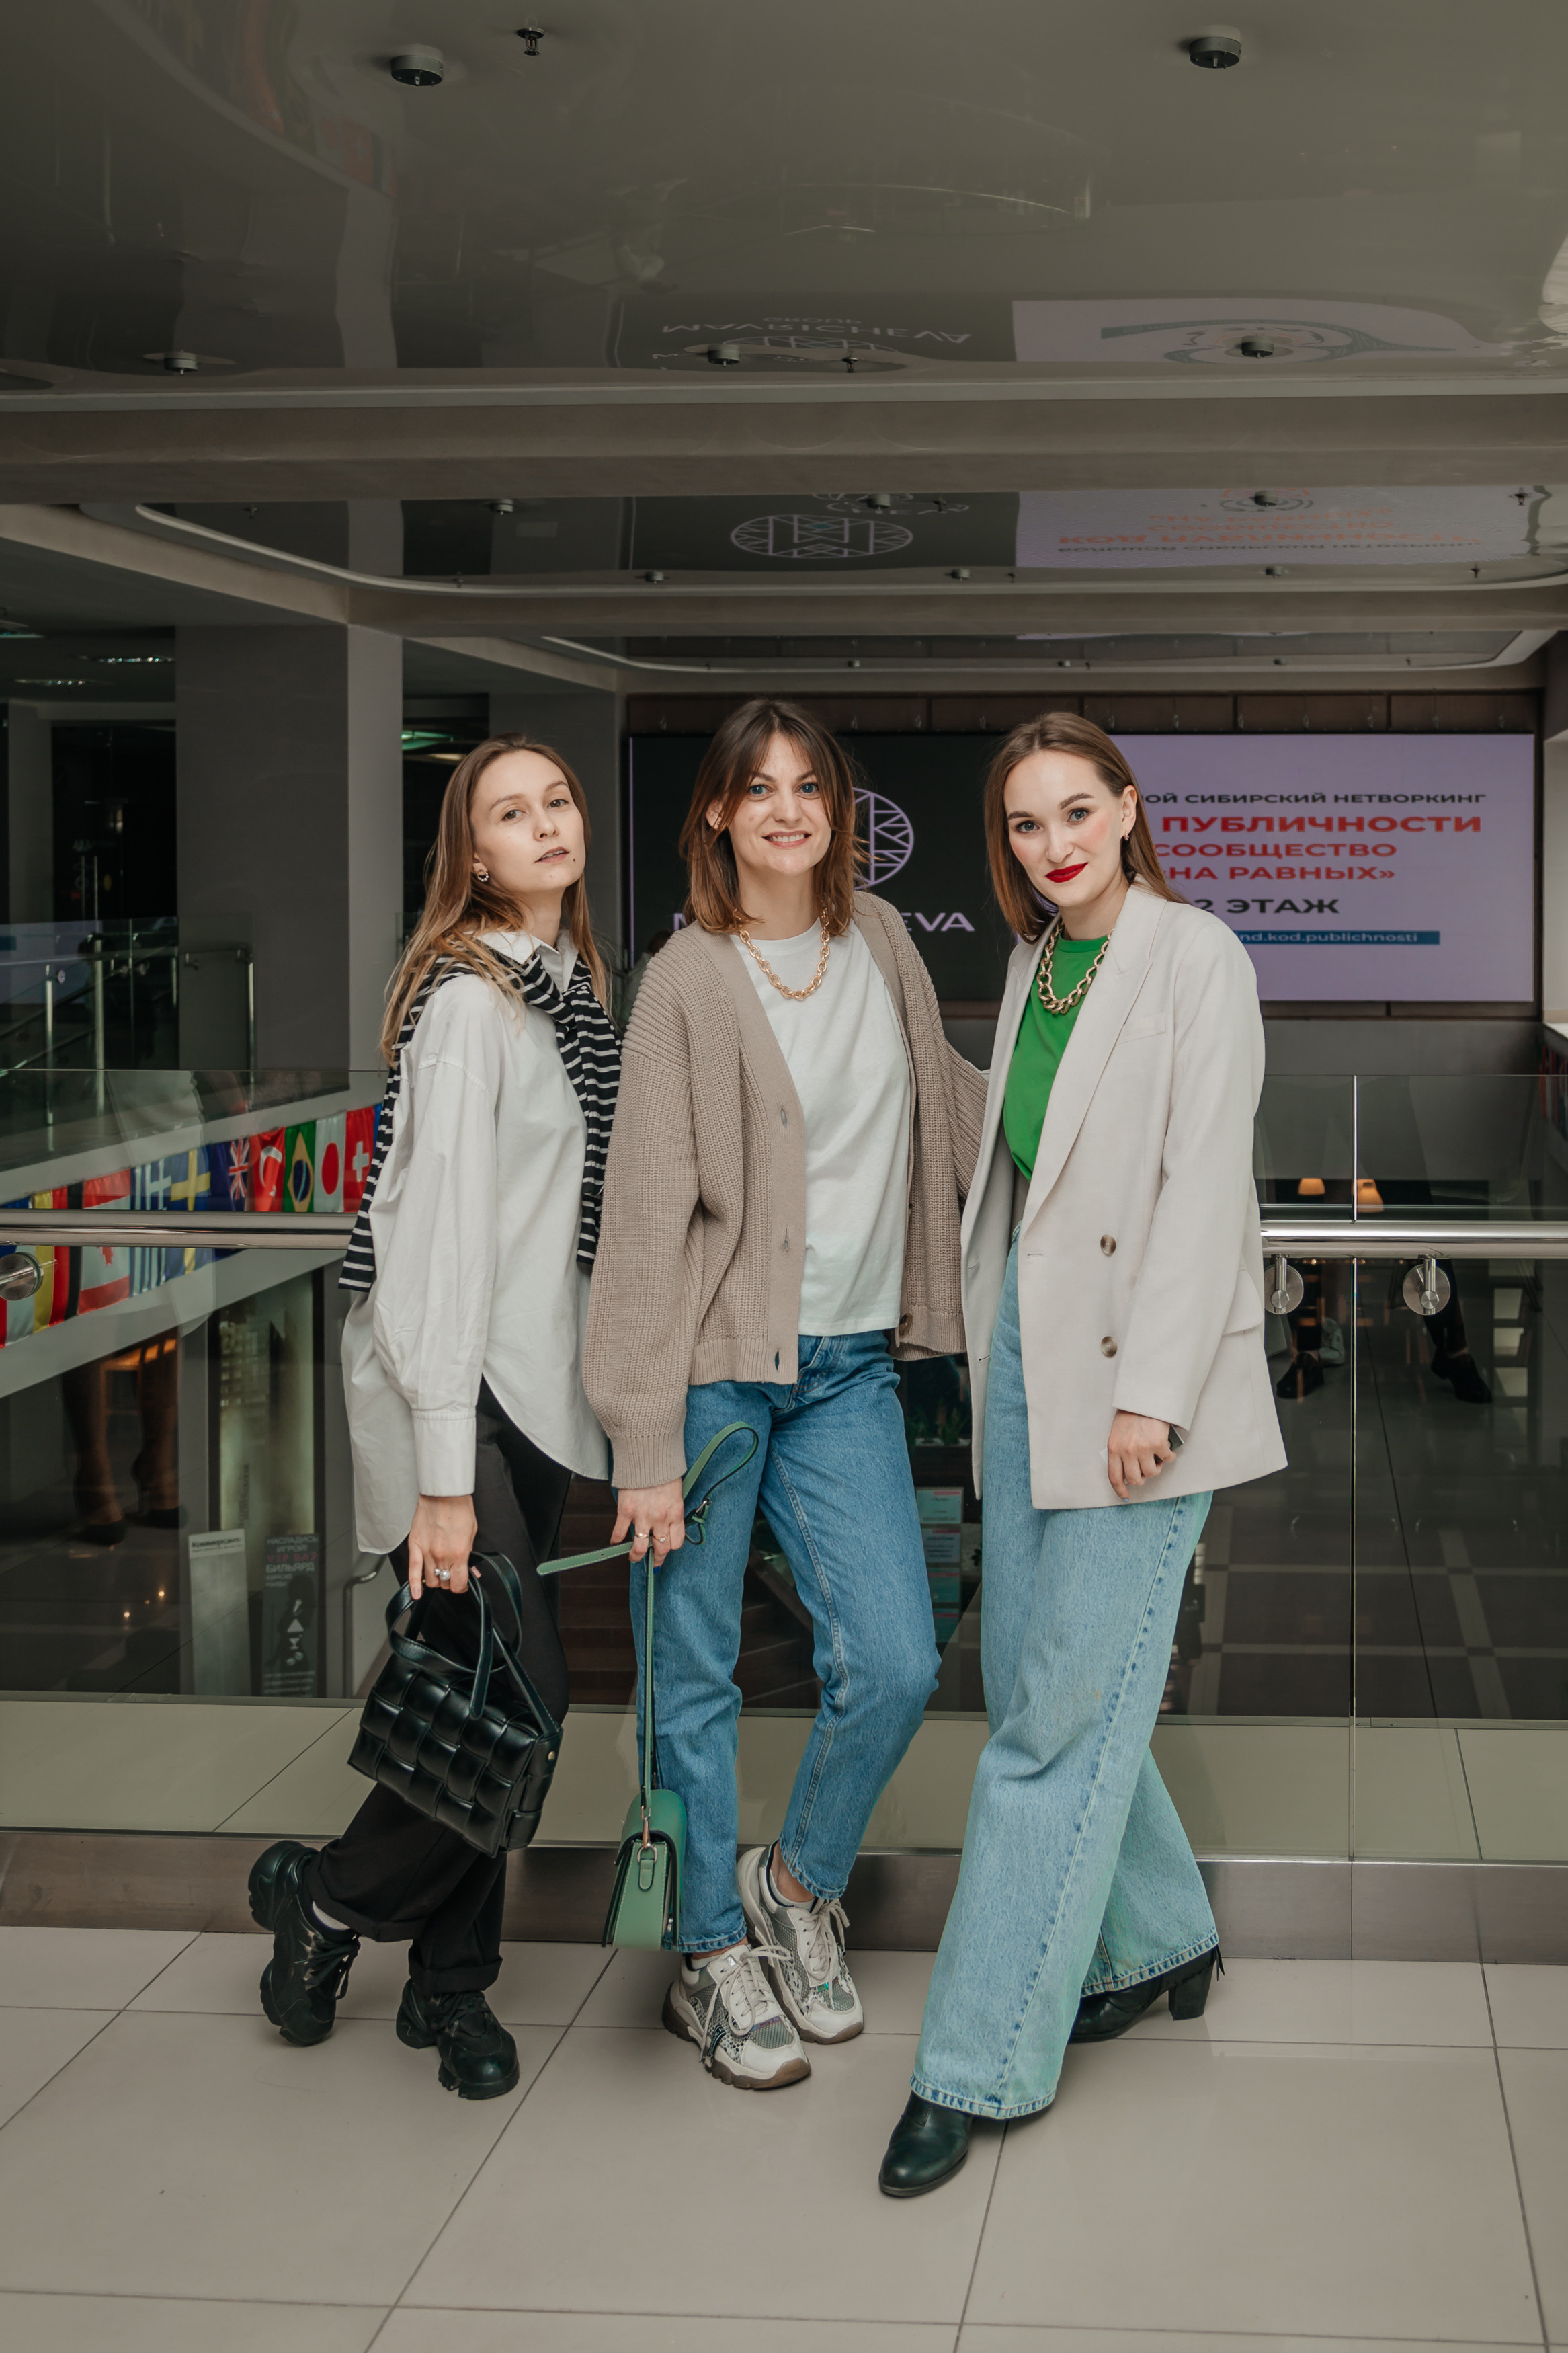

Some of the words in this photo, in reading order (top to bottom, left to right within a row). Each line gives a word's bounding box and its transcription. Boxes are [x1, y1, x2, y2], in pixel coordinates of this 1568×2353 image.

[1141, 793, 1178, 803] ОЙ
[1185, 793, 1326, 803] СИБИРСКИЙ
[1334, 794, 1486, 803] НЕТВОРКИНГ
[1162, 816, 1481, 832] ПУБЛИЧНОСТИ
[1154, 844, 1397, 859] СООБЩЕСТВО
[1163, 867, 1218, 880] НА
[1229, 867, 1395, 880] РАВНЫХ»
[1194, 899, 1214, 914] 2
[1226, 899, 1340, 914] ЭТАЖ
[1236, 932, 1418, 943] nd.kod.publichnosti
